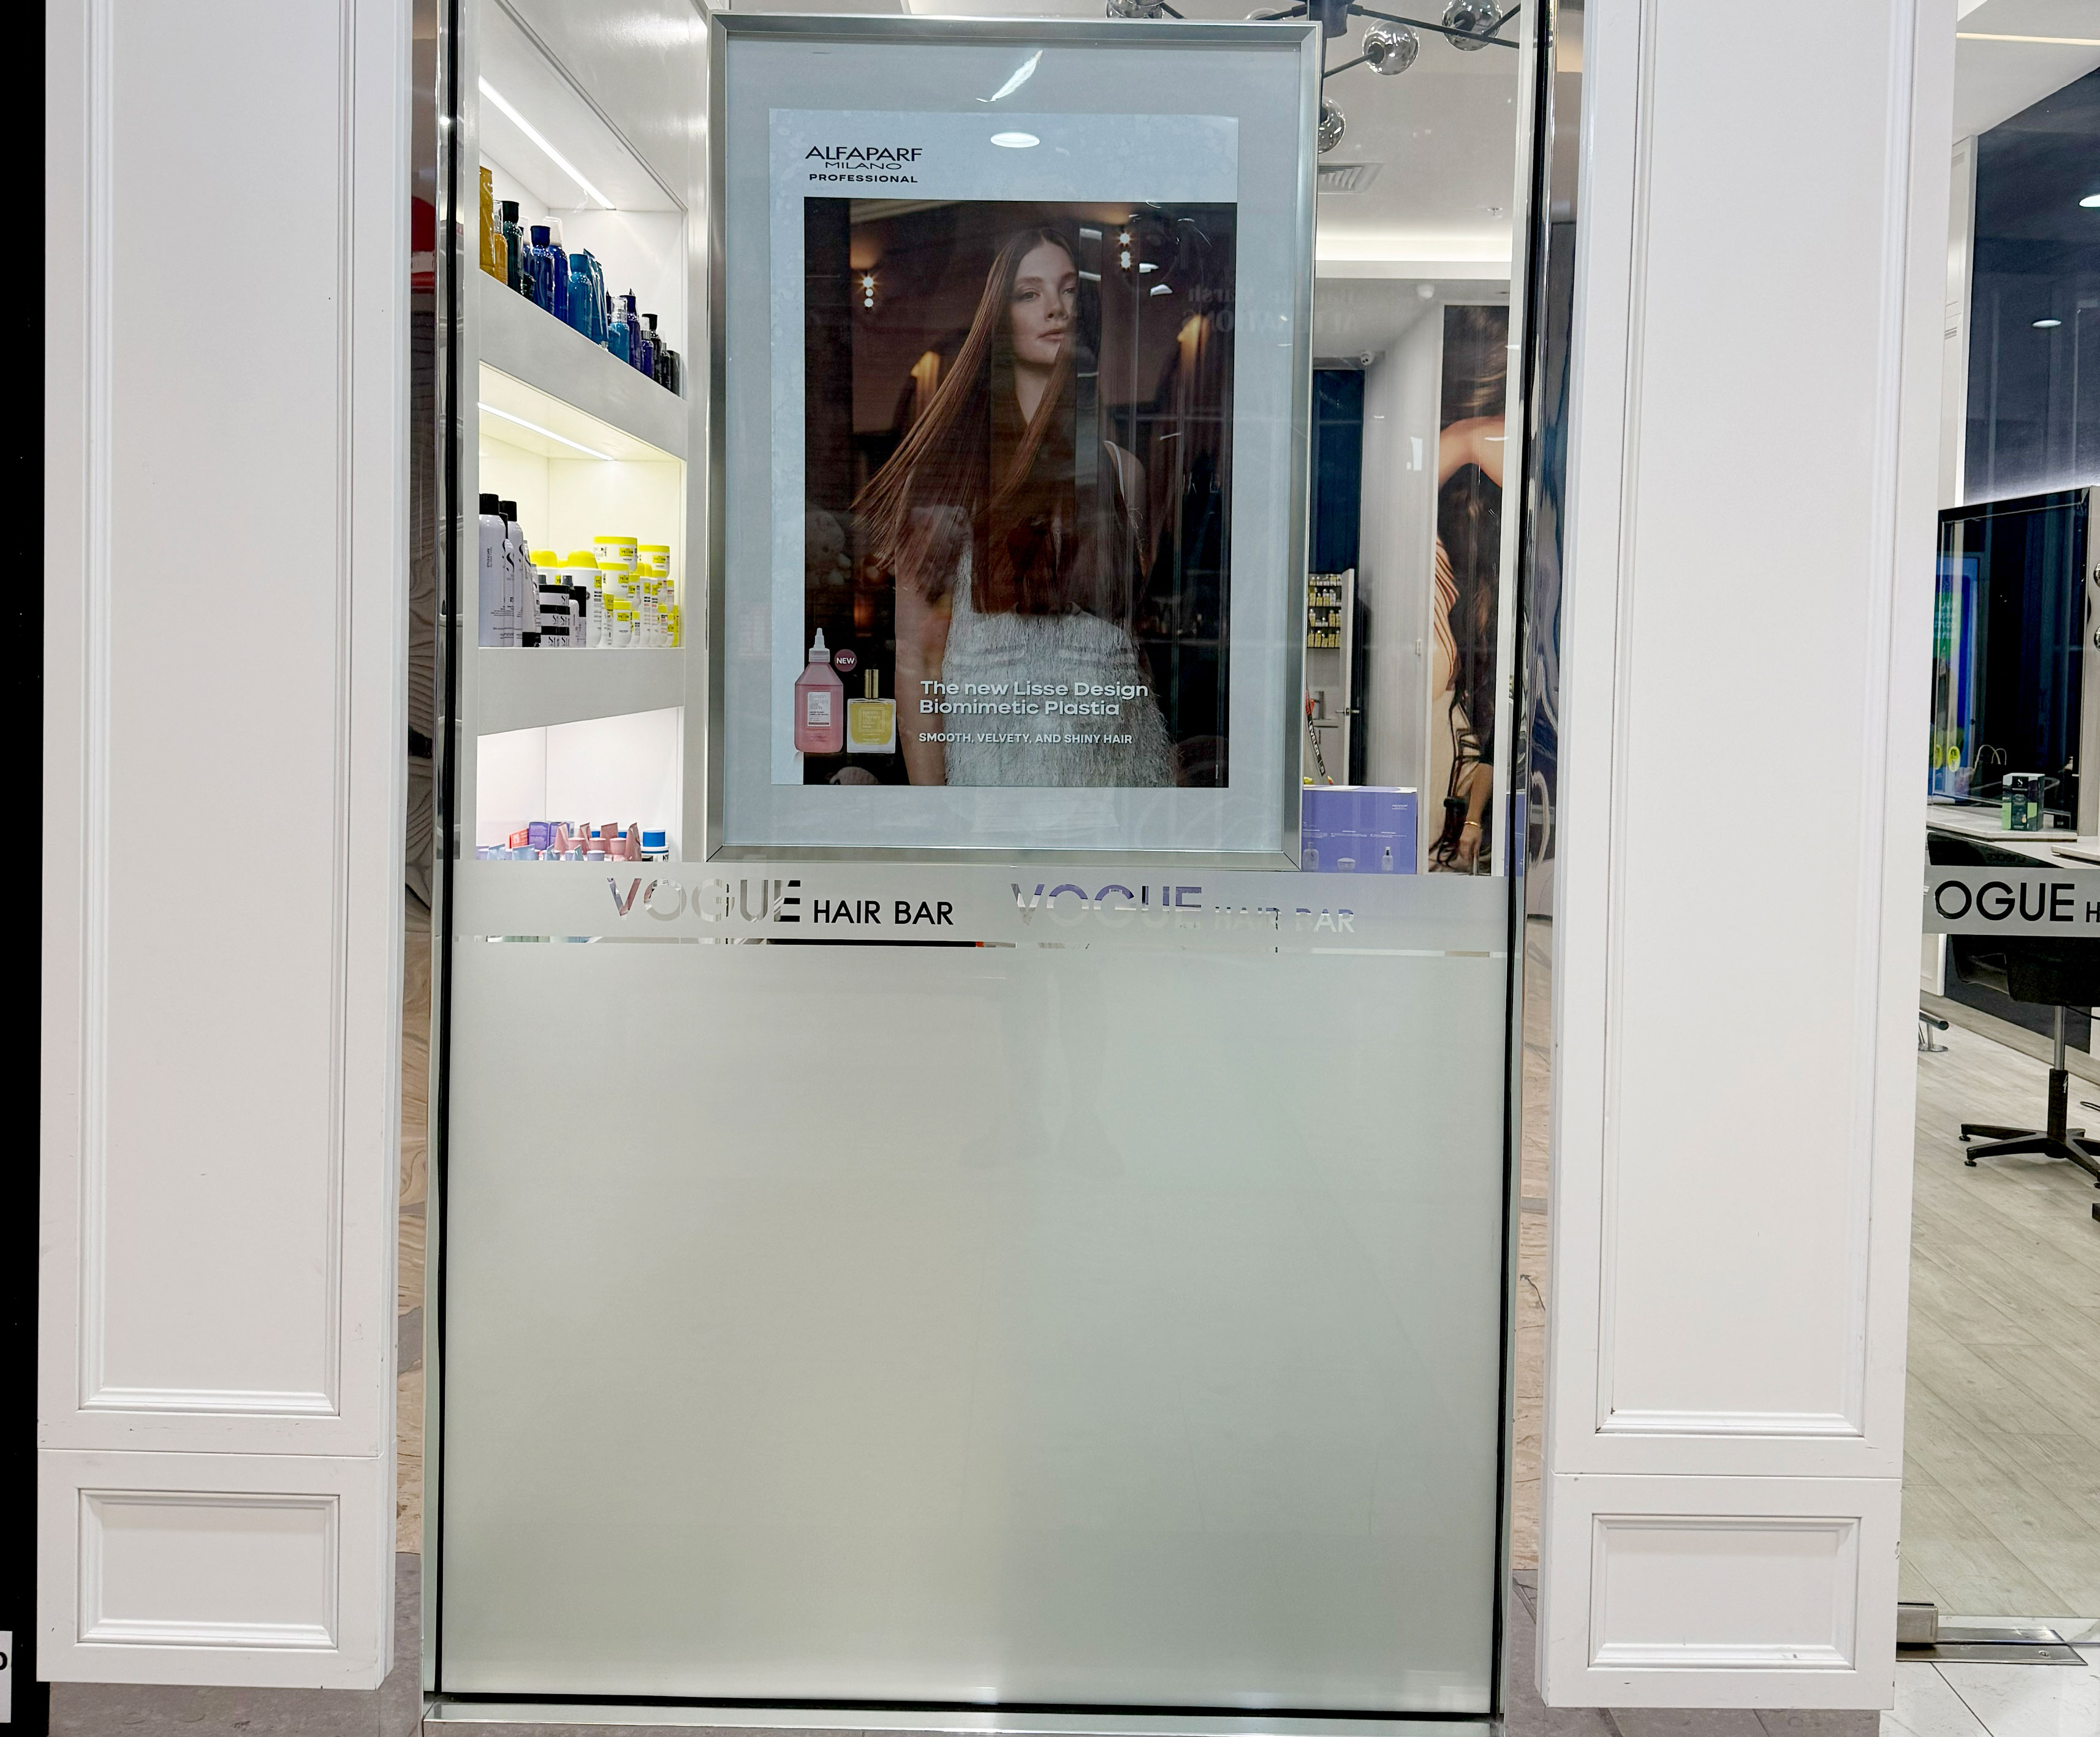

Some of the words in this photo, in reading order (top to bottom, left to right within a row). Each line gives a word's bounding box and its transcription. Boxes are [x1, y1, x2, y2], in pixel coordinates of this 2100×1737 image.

[805, 145, 923, 162] ALFAPARF
[825, 162, 902, 170] MILANO
[809, 173, 918, 183] PROFESSIONAL
[920, 680, 960, 695] The
[965, 684, 1009, 696] new
[1014, 681, 1069, 697] Lisse
[1074, 681, 1148, 700] Design
[919, 698, 1040, 714] Biomimetic
[1045, 700, 1120, 716] Plastia
[919, 733, 974, 744] SMOOTH,
[977, 733, 1033, 744] VELVETY,
[1035, 734, 1061, 744] AND
[1064, 735, 1101, 744] SHINY
[1104, 735, 1132, 744] HAIR
[607, 877, 802, 923] VOGUE
[813, 899, 881, 925] HAIR
[894, 901, 954, 925] BAR
[1010, 883, 1202, 929] VOGUE
[1295, 908, 1355, 934] BAR
[1934, 880, 2075, 921] OGUE
